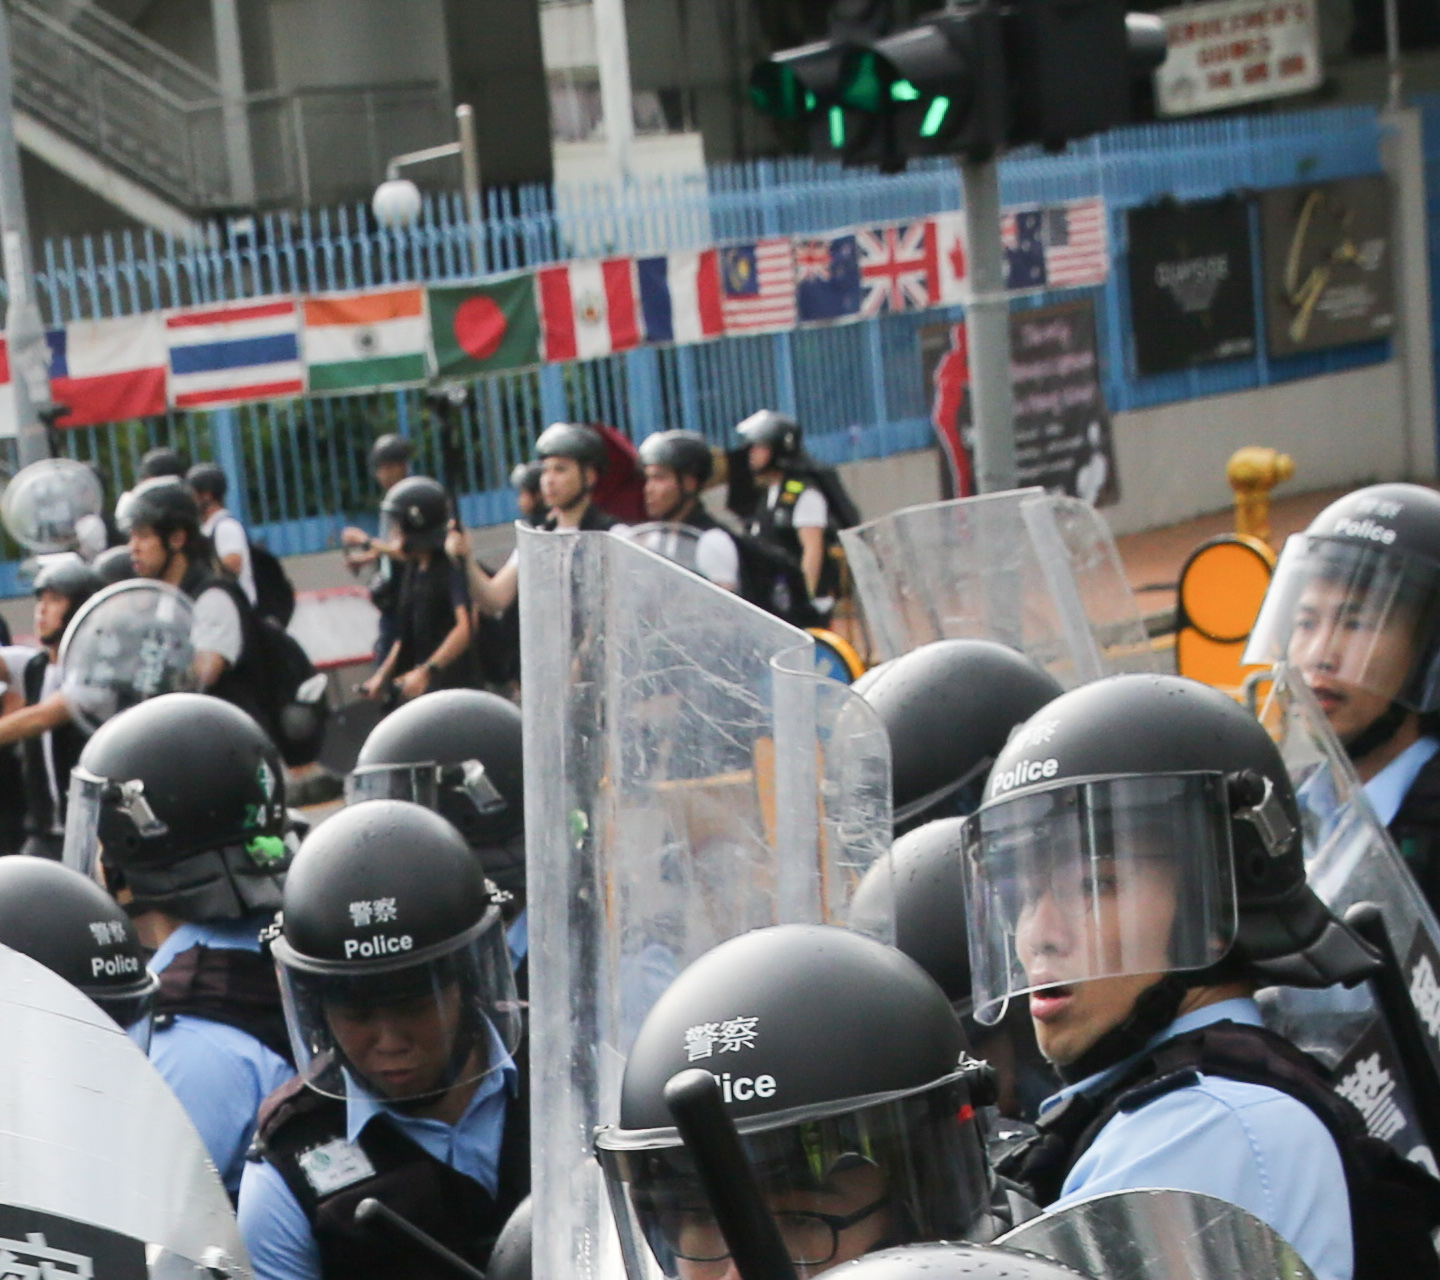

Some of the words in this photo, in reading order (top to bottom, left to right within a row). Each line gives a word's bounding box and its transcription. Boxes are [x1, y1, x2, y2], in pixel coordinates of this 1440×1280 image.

[1334, 519, 1397, 545] Police
[991, 758, 1059, 798] Police
[349, 898, 398, 928] 警察
[90, 920, 127, 946] 警察
[344, 935, 413, 960] Police
[91, 954, 139, 977] Police
[683, 1015, 759, 1062] 警察
